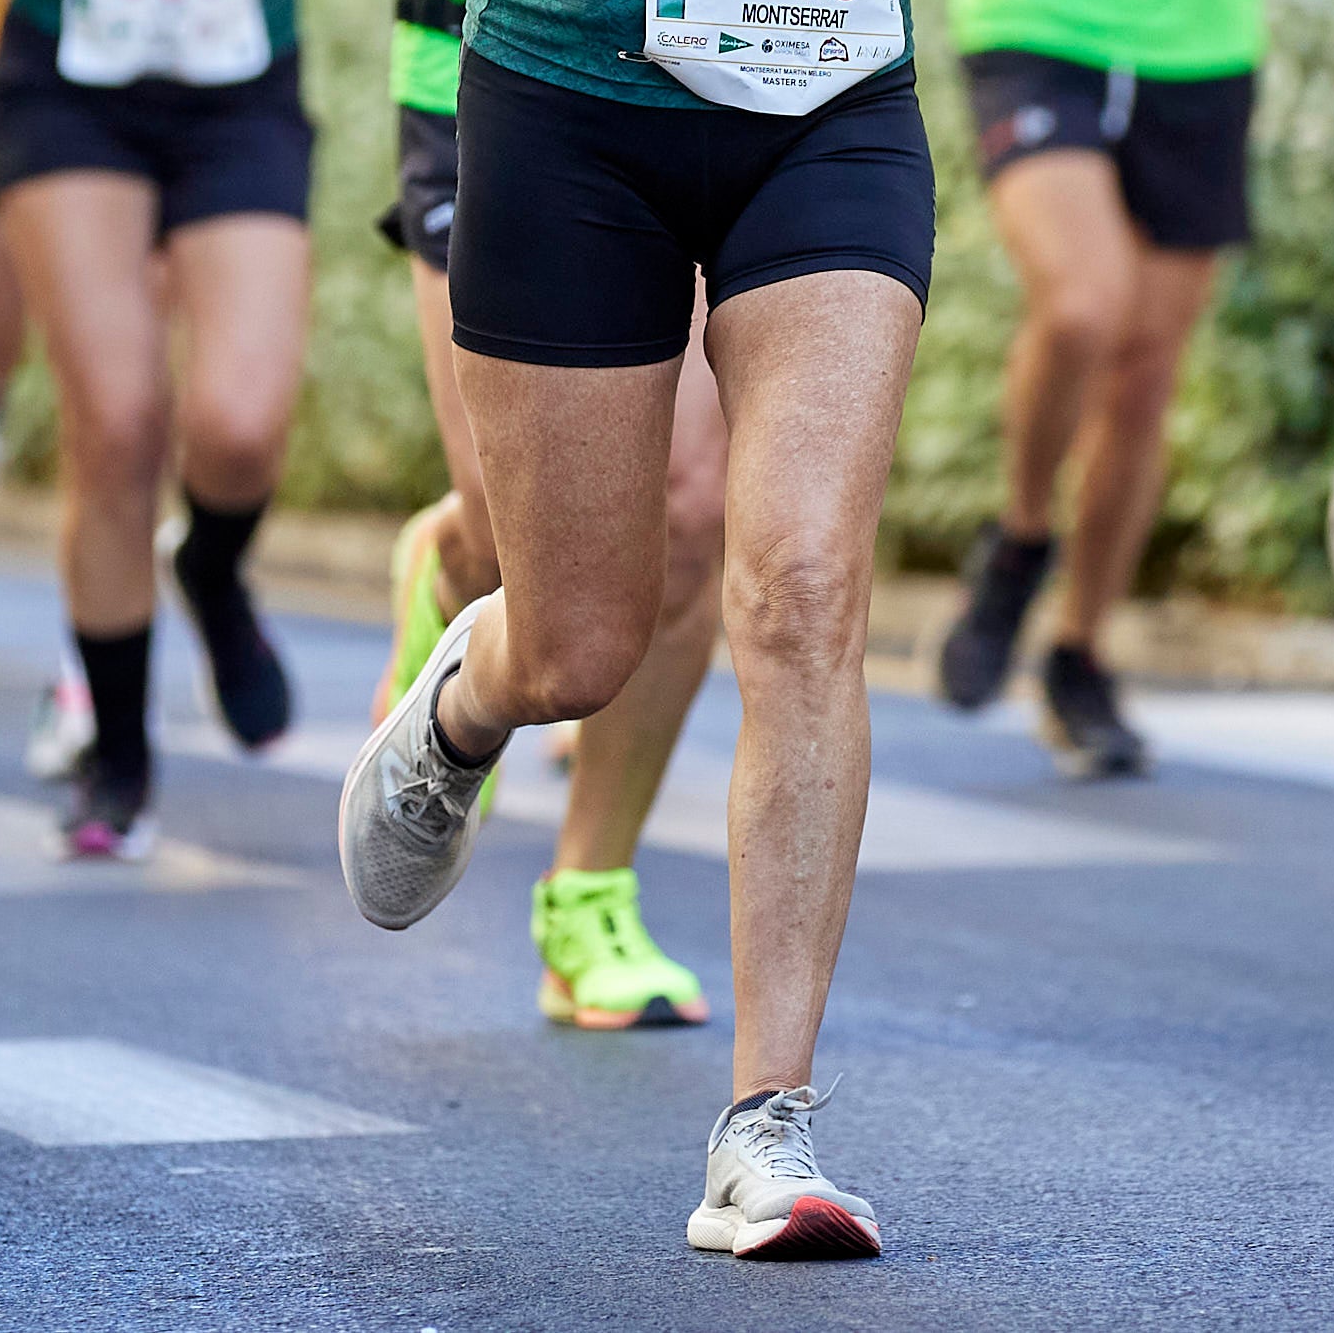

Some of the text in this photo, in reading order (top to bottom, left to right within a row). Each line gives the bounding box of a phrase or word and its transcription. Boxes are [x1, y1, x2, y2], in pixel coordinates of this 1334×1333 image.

[742, 3, 849, 30] MONTSERRAT
[661, 34, 708, 46] CALERO
[774, 39, 811, 49] OXIMESA
[740, 65, 782, 75] MONTSERRAT
[808, 70, 832, 78] MELERO
[762, 77, 808, 87] MASTER 55
